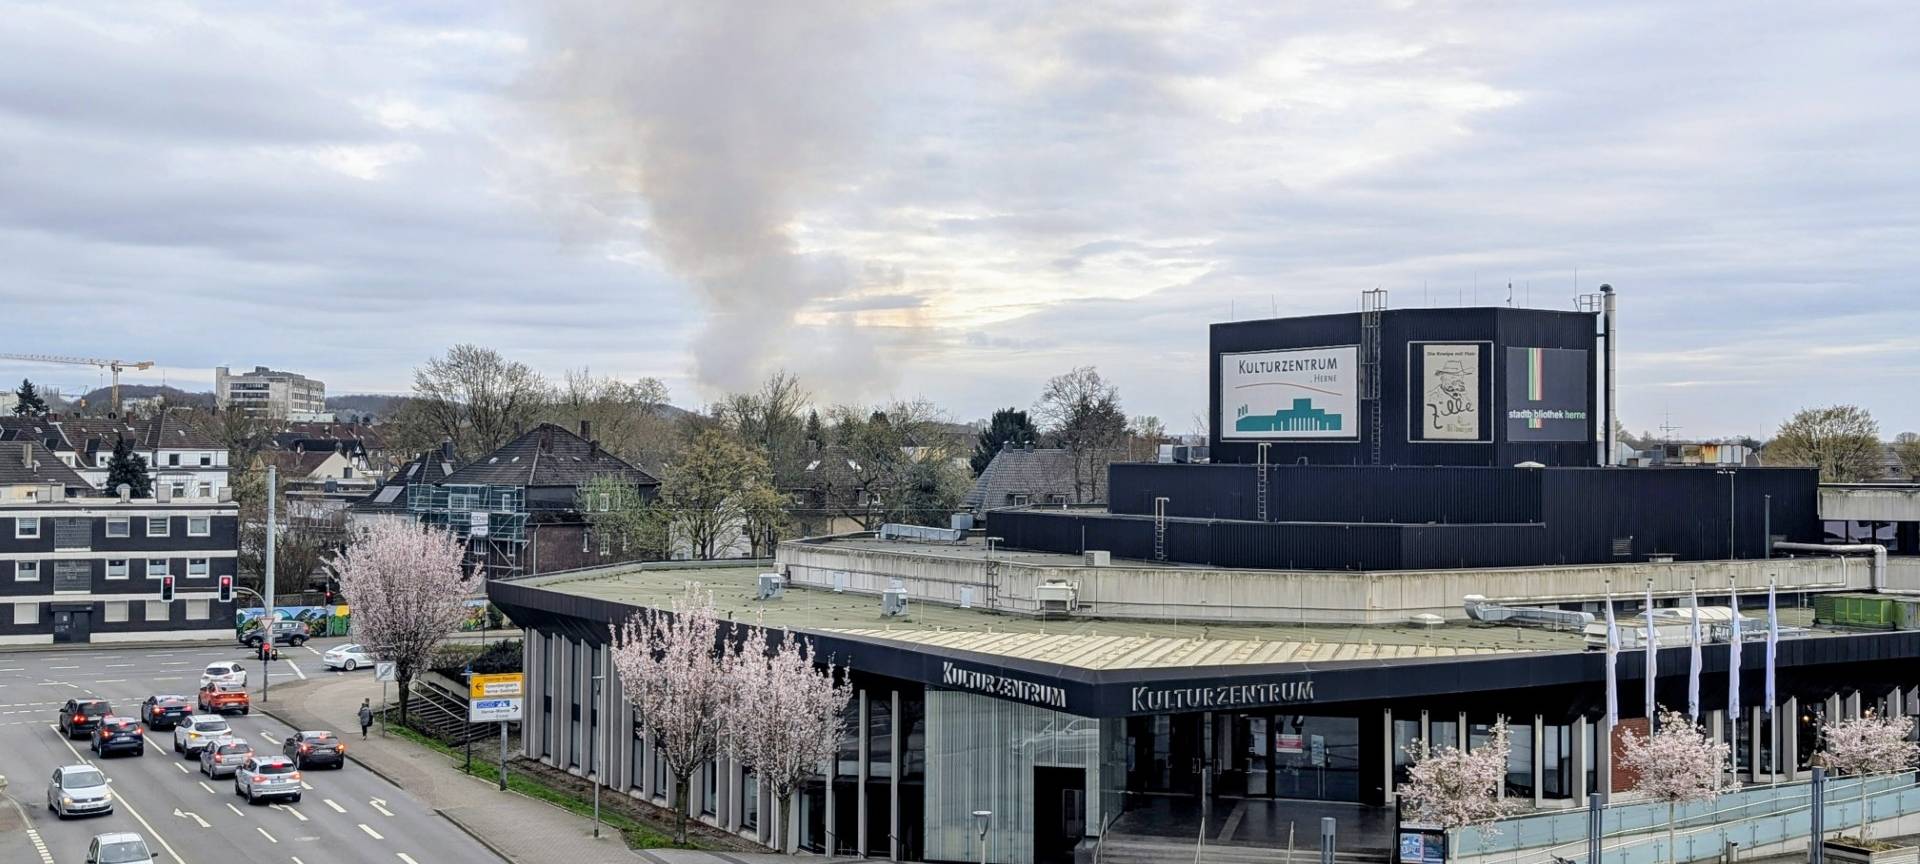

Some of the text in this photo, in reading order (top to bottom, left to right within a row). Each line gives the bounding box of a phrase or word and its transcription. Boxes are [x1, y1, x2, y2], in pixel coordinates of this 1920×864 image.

[1239, 358, 1338, 375] KULTURZENTRUM
[1426, 398, 1475, 430] Zille
[1565, 410, 1586, 419] herne
[943, 661, 1067, 708] KULTURZENTRUM
[1132, 681, 1314, 712] KULTURZENTRUM
